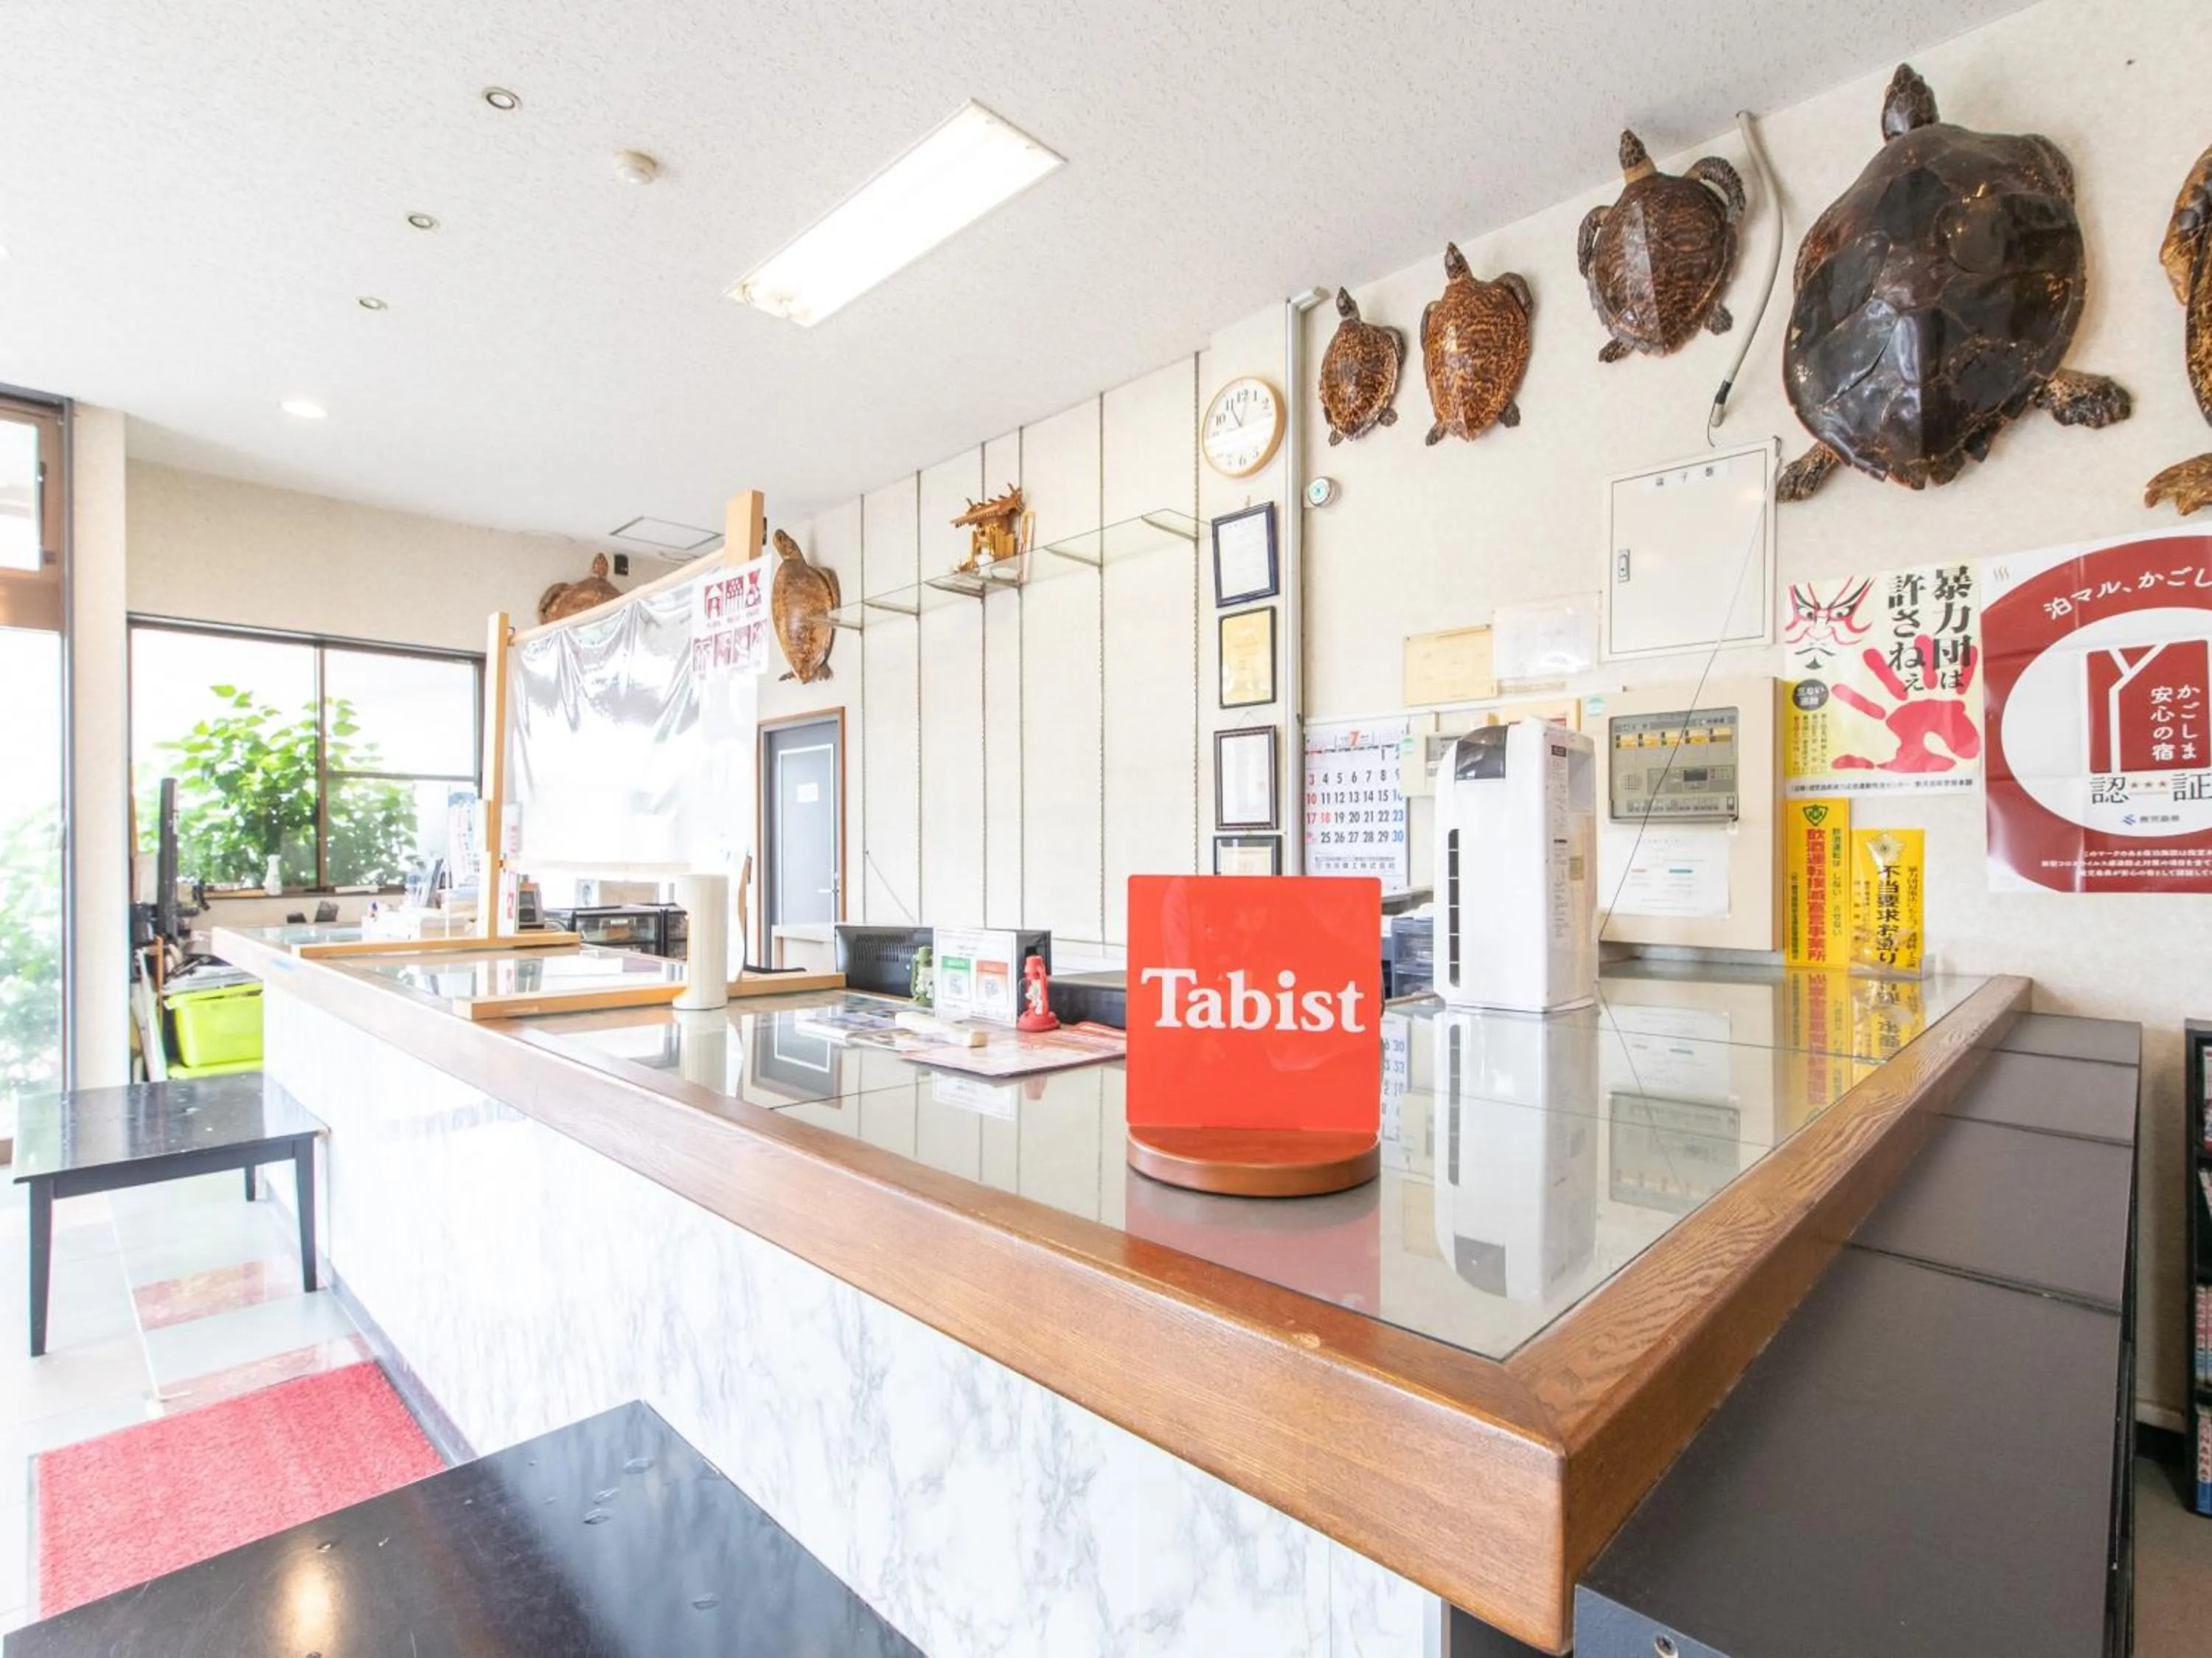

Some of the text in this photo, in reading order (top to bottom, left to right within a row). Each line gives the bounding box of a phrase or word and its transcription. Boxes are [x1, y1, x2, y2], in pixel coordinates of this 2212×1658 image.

[1933, 564, 1972, 690] 暴力団は
[2150, 685, 2174, 761] 安心の宿
[2177, 684, 2200, 760] かごしま
[1349, 731, 1360, 746] 7
[1310, 774, 1315, 785] 3
[1322, 773, 1329, 785] 4
[1337, 772, 1343, 784] 5
[1352, 771, 1357, 783] 6
[1366, 771, 1371, 783] 7
[1380, 769, 1386, 781] 8
[1307, 794, 1317, 805] 10
[1321, 793, 1330, 804] 11
[1335, 792, 1345, 803] 12
[1349, 791, 1359, 802] 13
[1364, 791, 1374, 802] 14
[1378, 790, 1388, 802] 15
[2090, 776, 2129, 804] 認
[1307, 811, 1404, 824] 17 18 19 20 21 22 23
[1321, 833, 1330, 844] 25
[1335, 833, 1345, 843] 26
[1349, 832, 1359, 843] 27
[1363, 832, 1374, 842] 28
[1378, 831, 1388, 842] 29
[1393, 830, 1404, 842] 30
[1141, 967, 1366, 1033] Tabist
